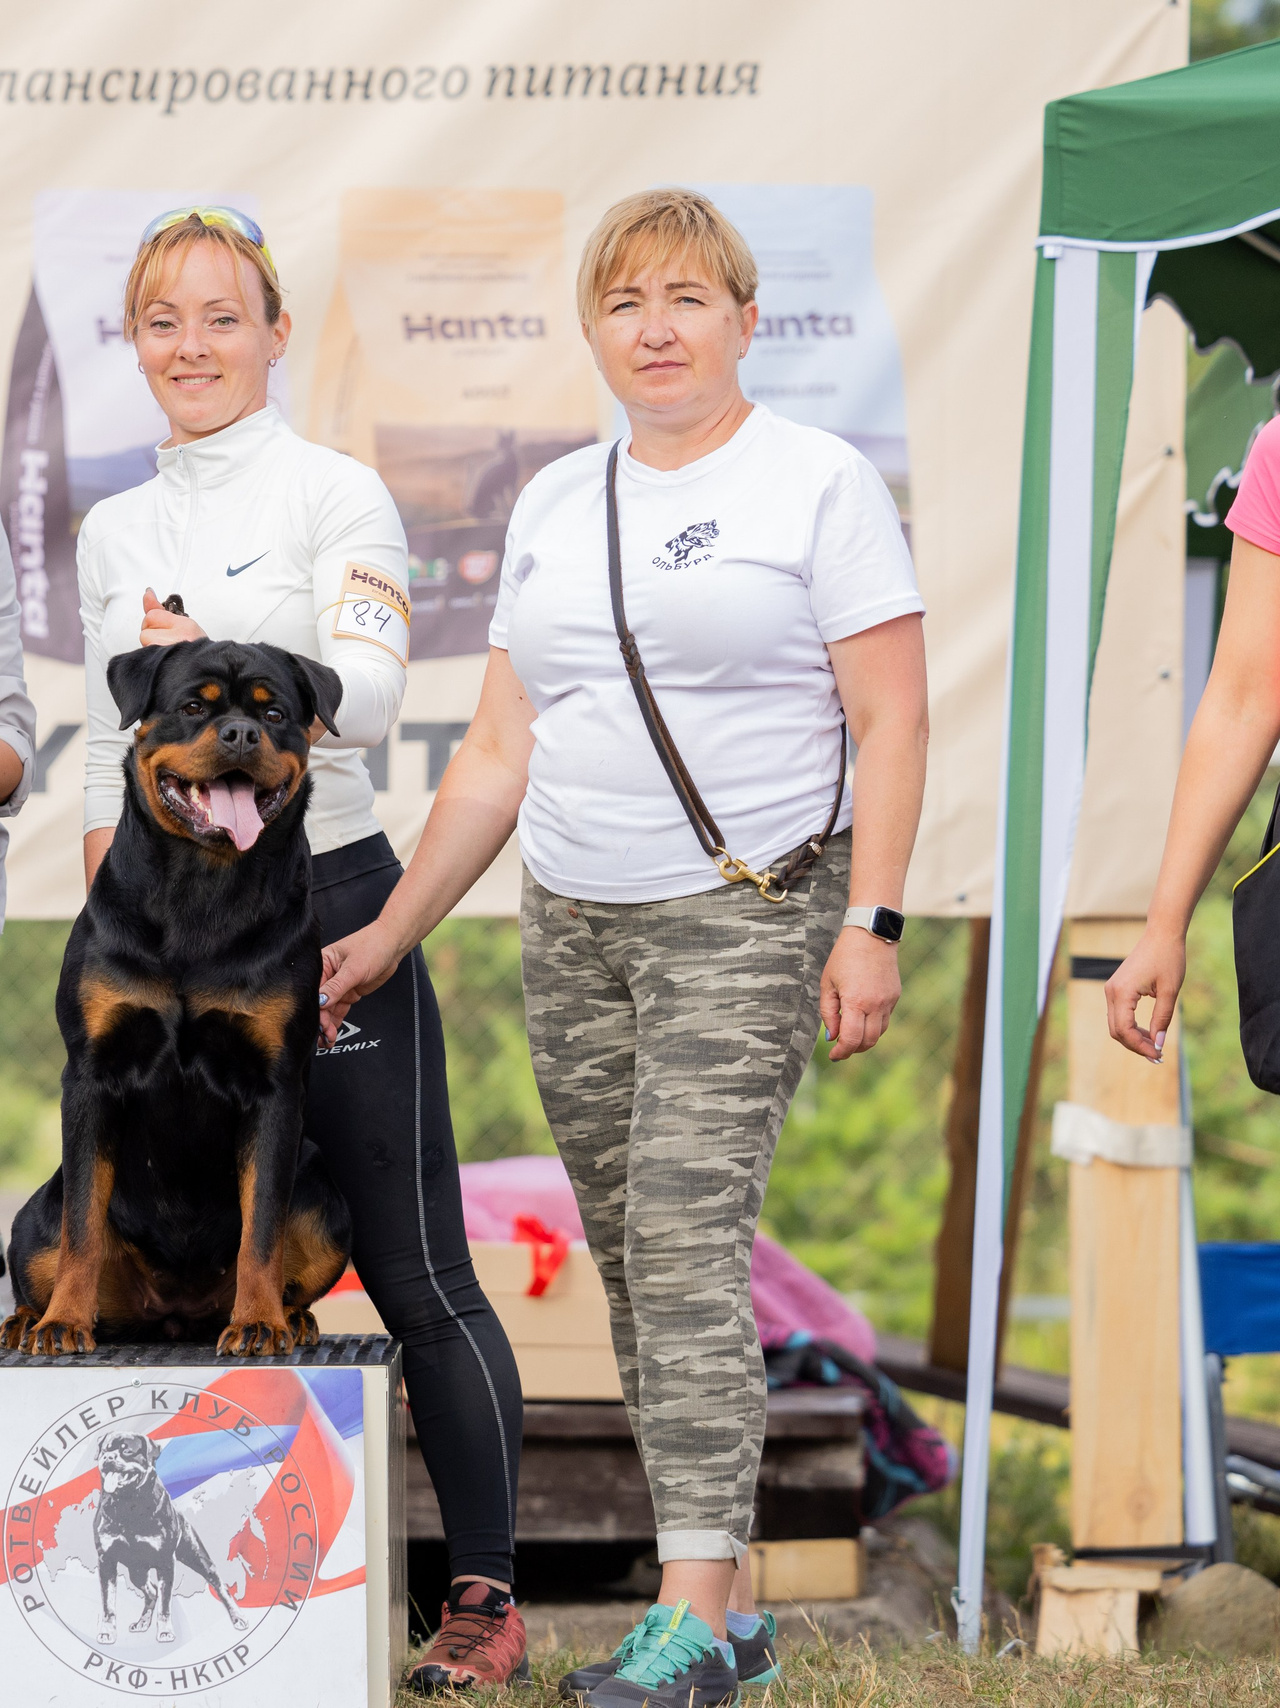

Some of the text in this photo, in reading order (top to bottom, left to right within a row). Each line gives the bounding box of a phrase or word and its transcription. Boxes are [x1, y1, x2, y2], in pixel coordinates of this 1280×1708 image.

[484, 60, 760, 99] питания
[402, 311, 546, 341] Hanta
[752, 311, 854, 338] anta
[351, 569, 409, 615] Hanta
[353, 600, 392, 632] 84
[315, 1039, 381, 1056] DEMIX
[10, 1389, 314, 1613] РОТВЕЙЛЕР КЛУБ РОССИИ
[84, 1644, 250, 1690] РКФ-НКПР
